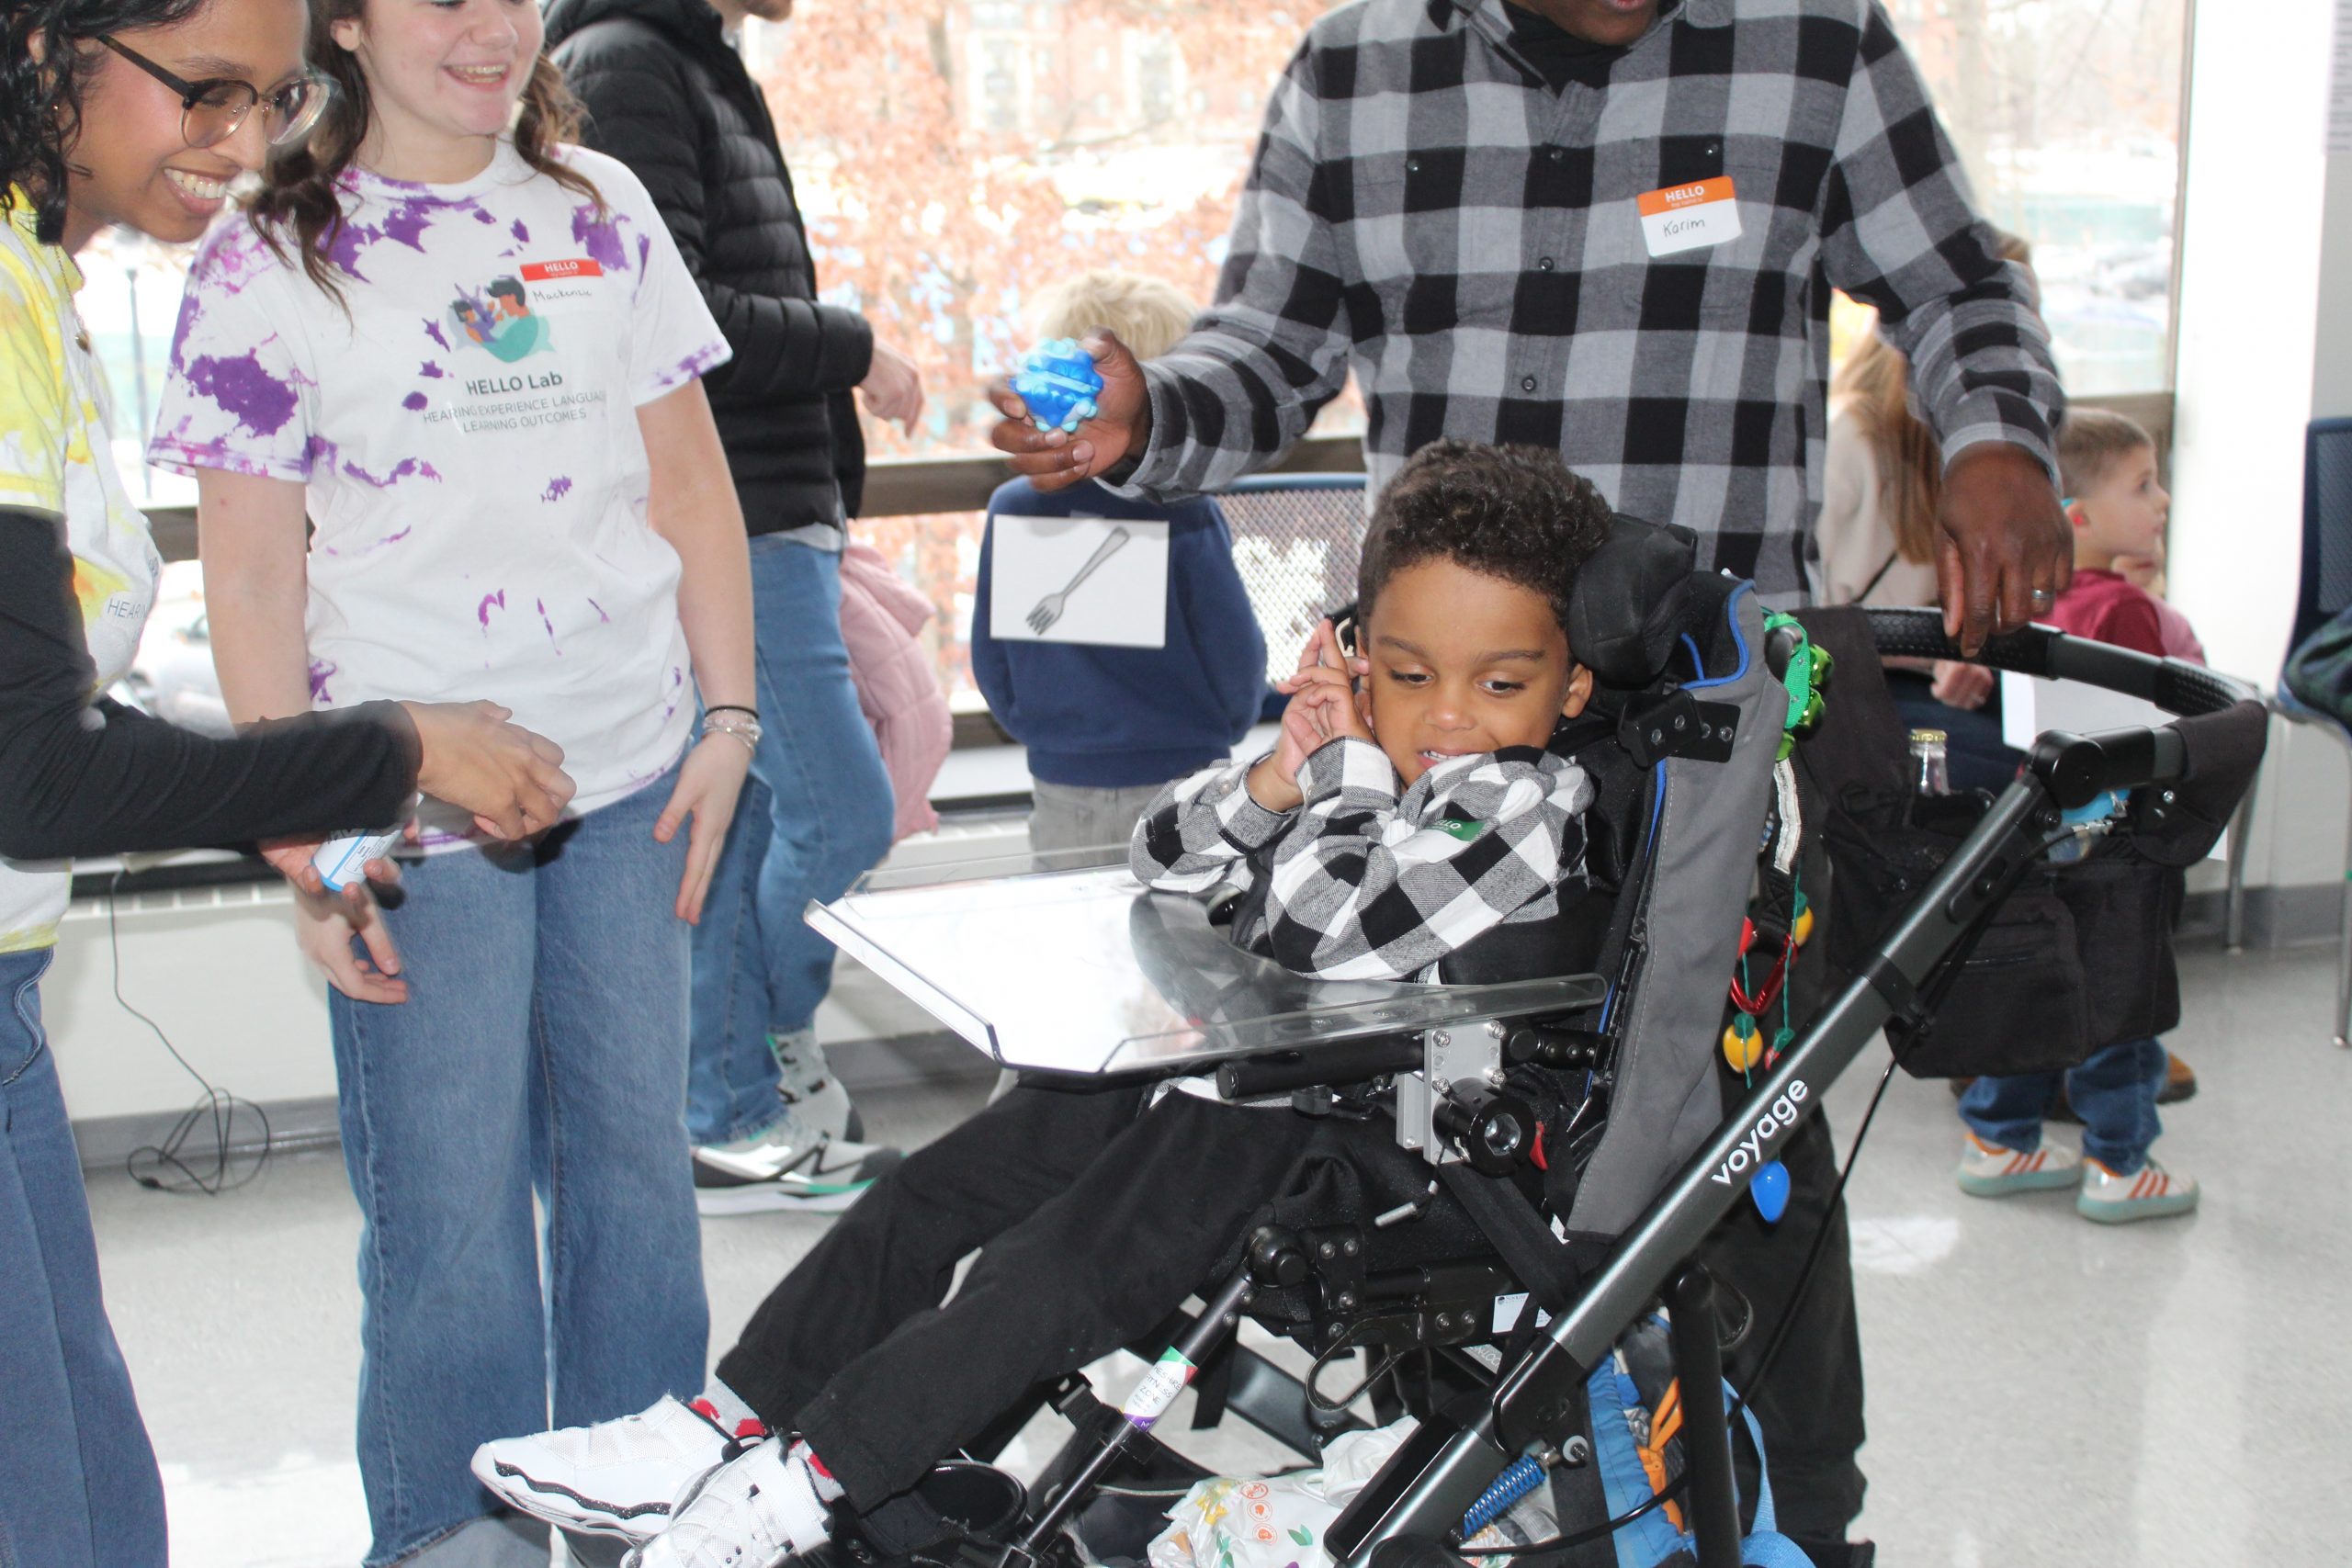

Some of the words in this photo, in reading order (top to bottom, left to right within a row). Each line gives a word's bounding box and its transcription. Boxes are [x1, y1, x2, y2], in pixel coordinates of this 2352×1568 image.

[1665, 185, 1705, 202] HELLO
[1663, 219, 1705, 237] Karim
[544, 261, 578, 273] HELLO
[466, 375, 523, 396] HELLO
[527, 371, 563, 389] Lab
[423, 404, 477, 424] HEARING
[478, 398, 549, 416] EXPERIENCE
[463, 417, 517, 434] LEARNING
[521, 408, 587, 427] OUTCOMES
[1712, 1079, 1808, 1184] voyage
